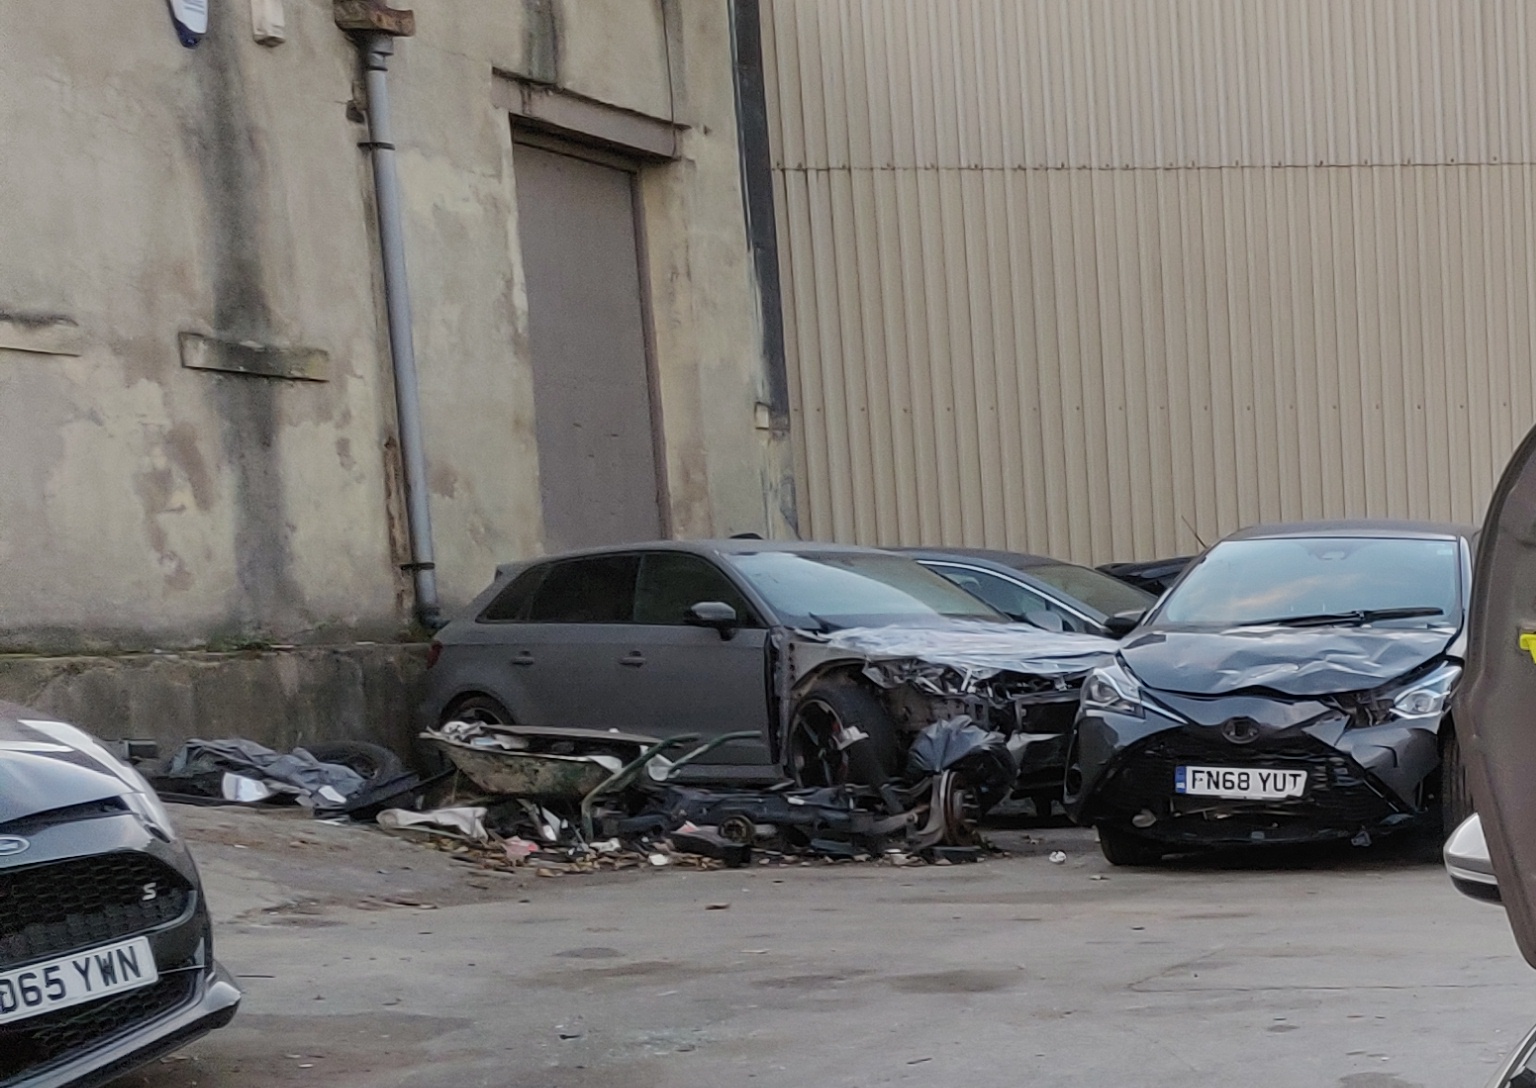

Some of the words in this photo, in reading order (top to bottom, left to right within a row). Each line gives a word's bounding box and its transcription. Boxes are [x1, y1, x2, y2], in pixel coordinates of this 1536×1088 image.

[1190, 769, 1250, 791] FN68
[1258, 772, 1303, 792] YUT
[72, 945, 142, 992] YWN
